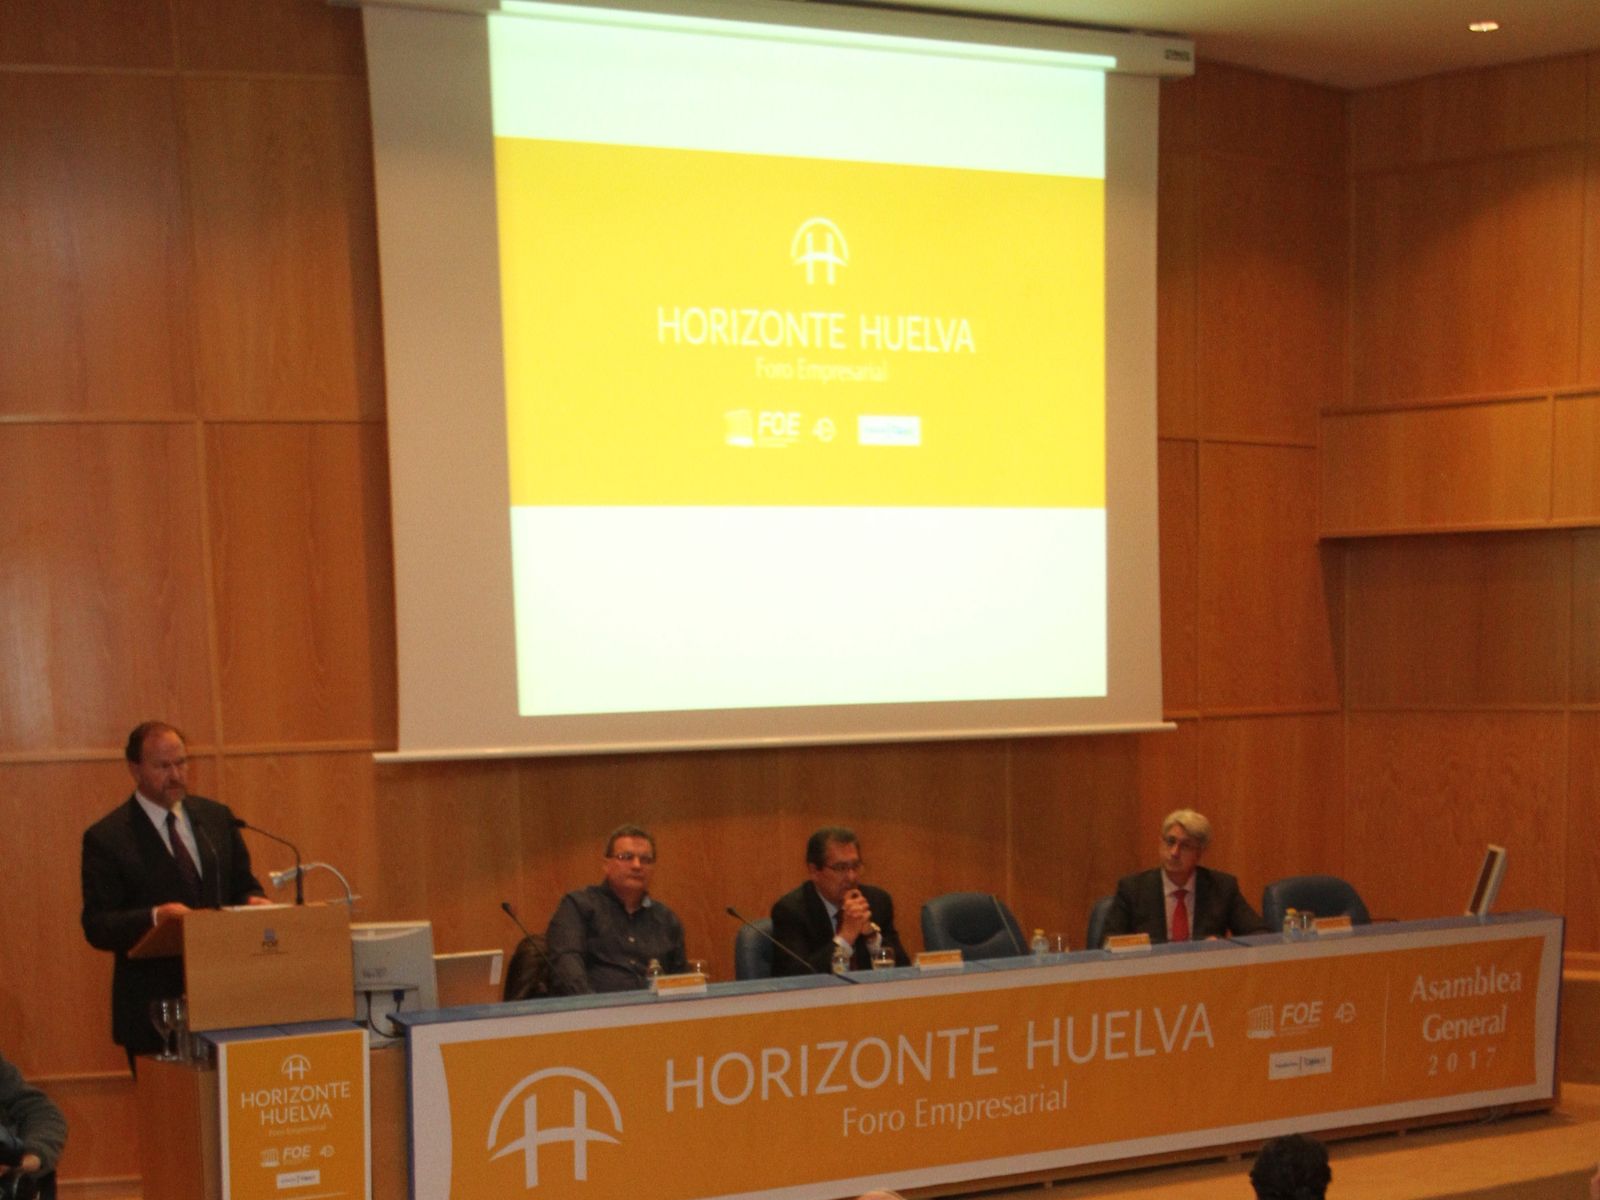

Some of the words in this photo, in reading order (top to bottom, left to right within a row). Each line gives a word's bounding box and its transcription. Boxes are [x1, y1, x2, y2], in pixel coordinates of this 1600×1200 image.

[656, 305, 846, 350] HORIZONTE
[859, 313, 977, 353] HUELVA
[755, 357, 793, 381] Foro
[796, 358, 888, 384] Empresarial
[757, 410, 801, 437] FOE
[1409, 964, 1522, 1004] Asamblea
[1280, 1000, 1323, 1026] FOE
[1422, 1004, 1508, 1043] General
[663, 1024, 1000, 1113] HORIZONTE
[1025, 1002, 1215, 1071] HUELVA
[240, 1081, 352, 1109] HORIZONTE
[841, 1105, 906, 1137] Foro
[914, 1079, 1069, 1131] Empresarial
[260, 1103, 333, 1126] HUELVA
[282, 1144, 312, 1161] FOE
